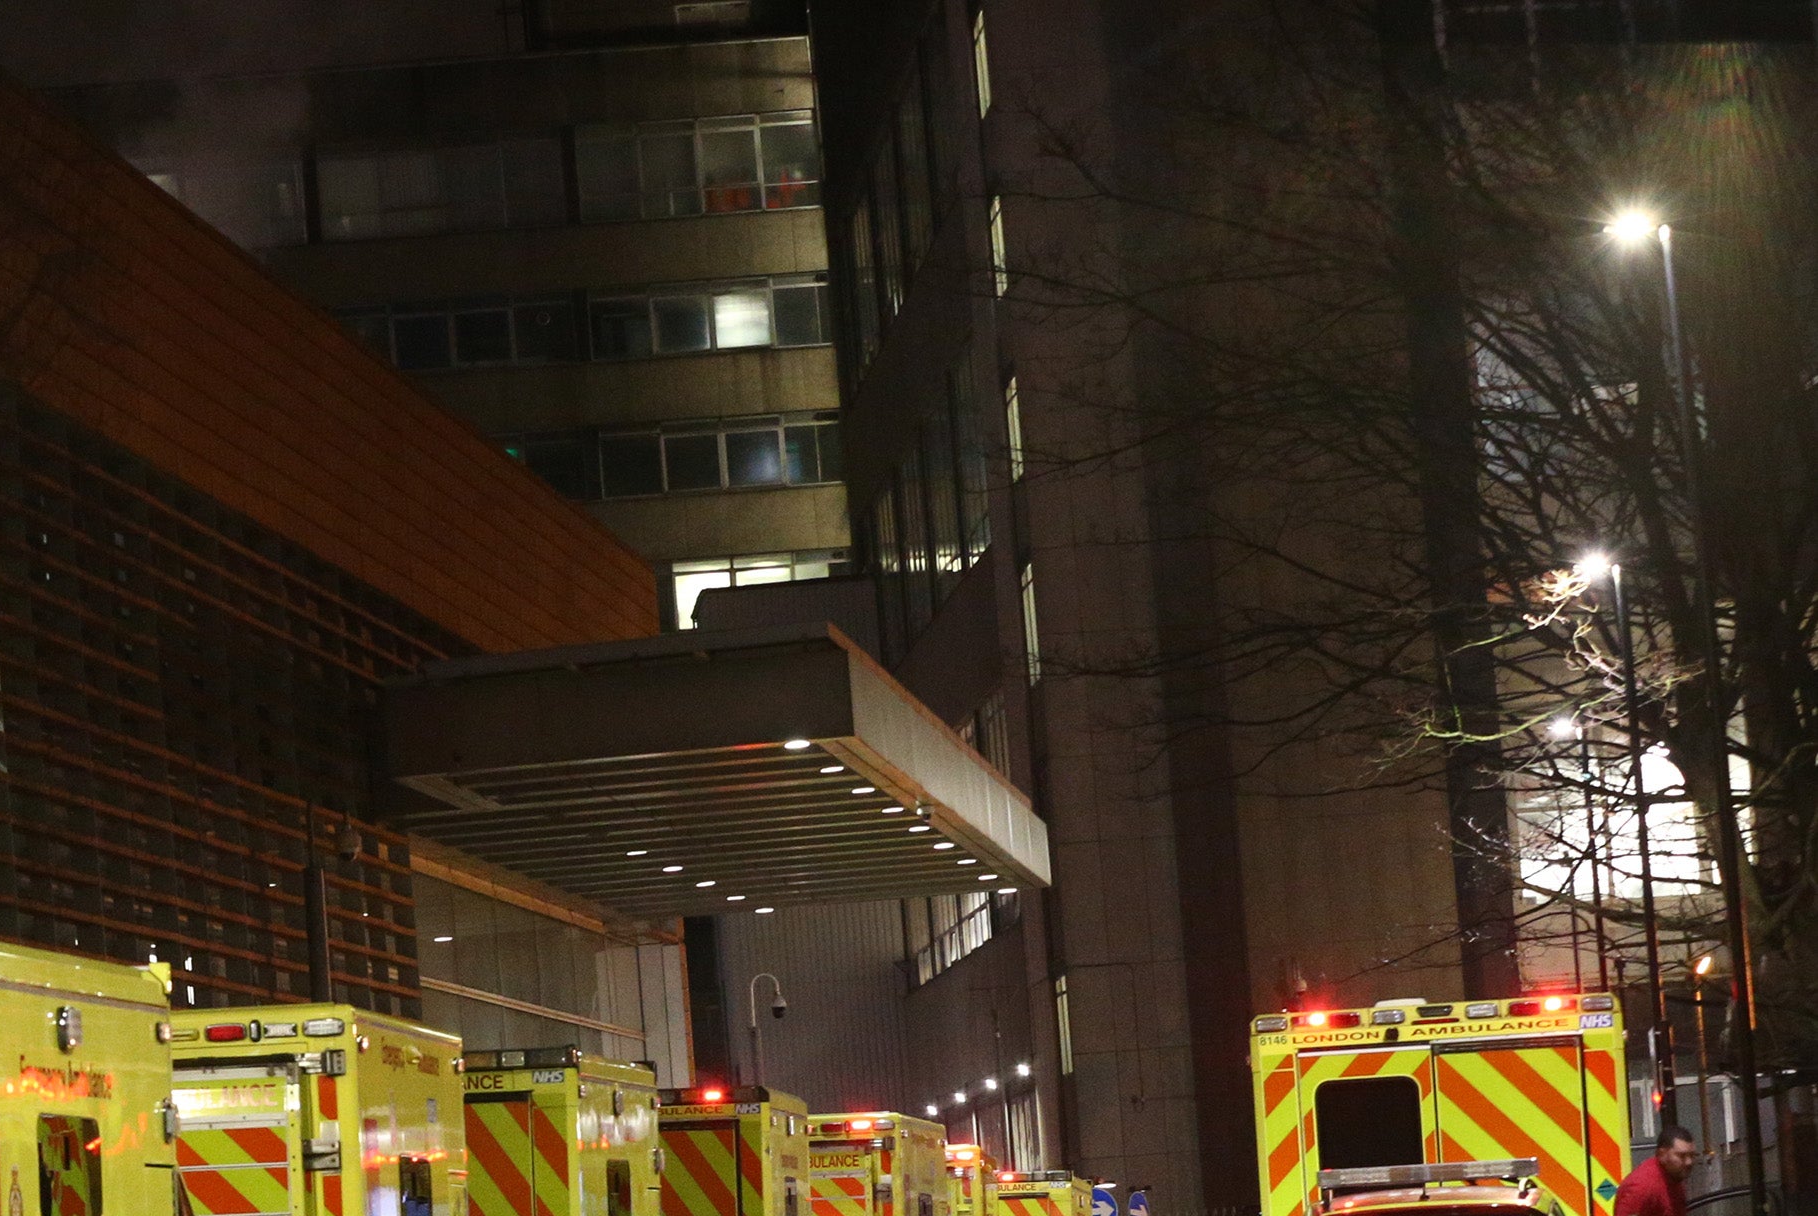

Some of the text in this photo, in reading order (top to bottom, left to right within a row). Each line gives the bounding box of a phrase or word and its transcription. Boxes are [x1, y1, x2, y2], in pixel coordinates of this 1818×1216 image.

[1580, 1014, 1612, 1029] NHS
[1292, 1019, 1570, 1045] LONDON AMBULANCE
[1259, 1035, 1287, 1046] 8146
[533, 1069, 564, 1083] NHS
[735, 1103, 760, 1114] NHS
